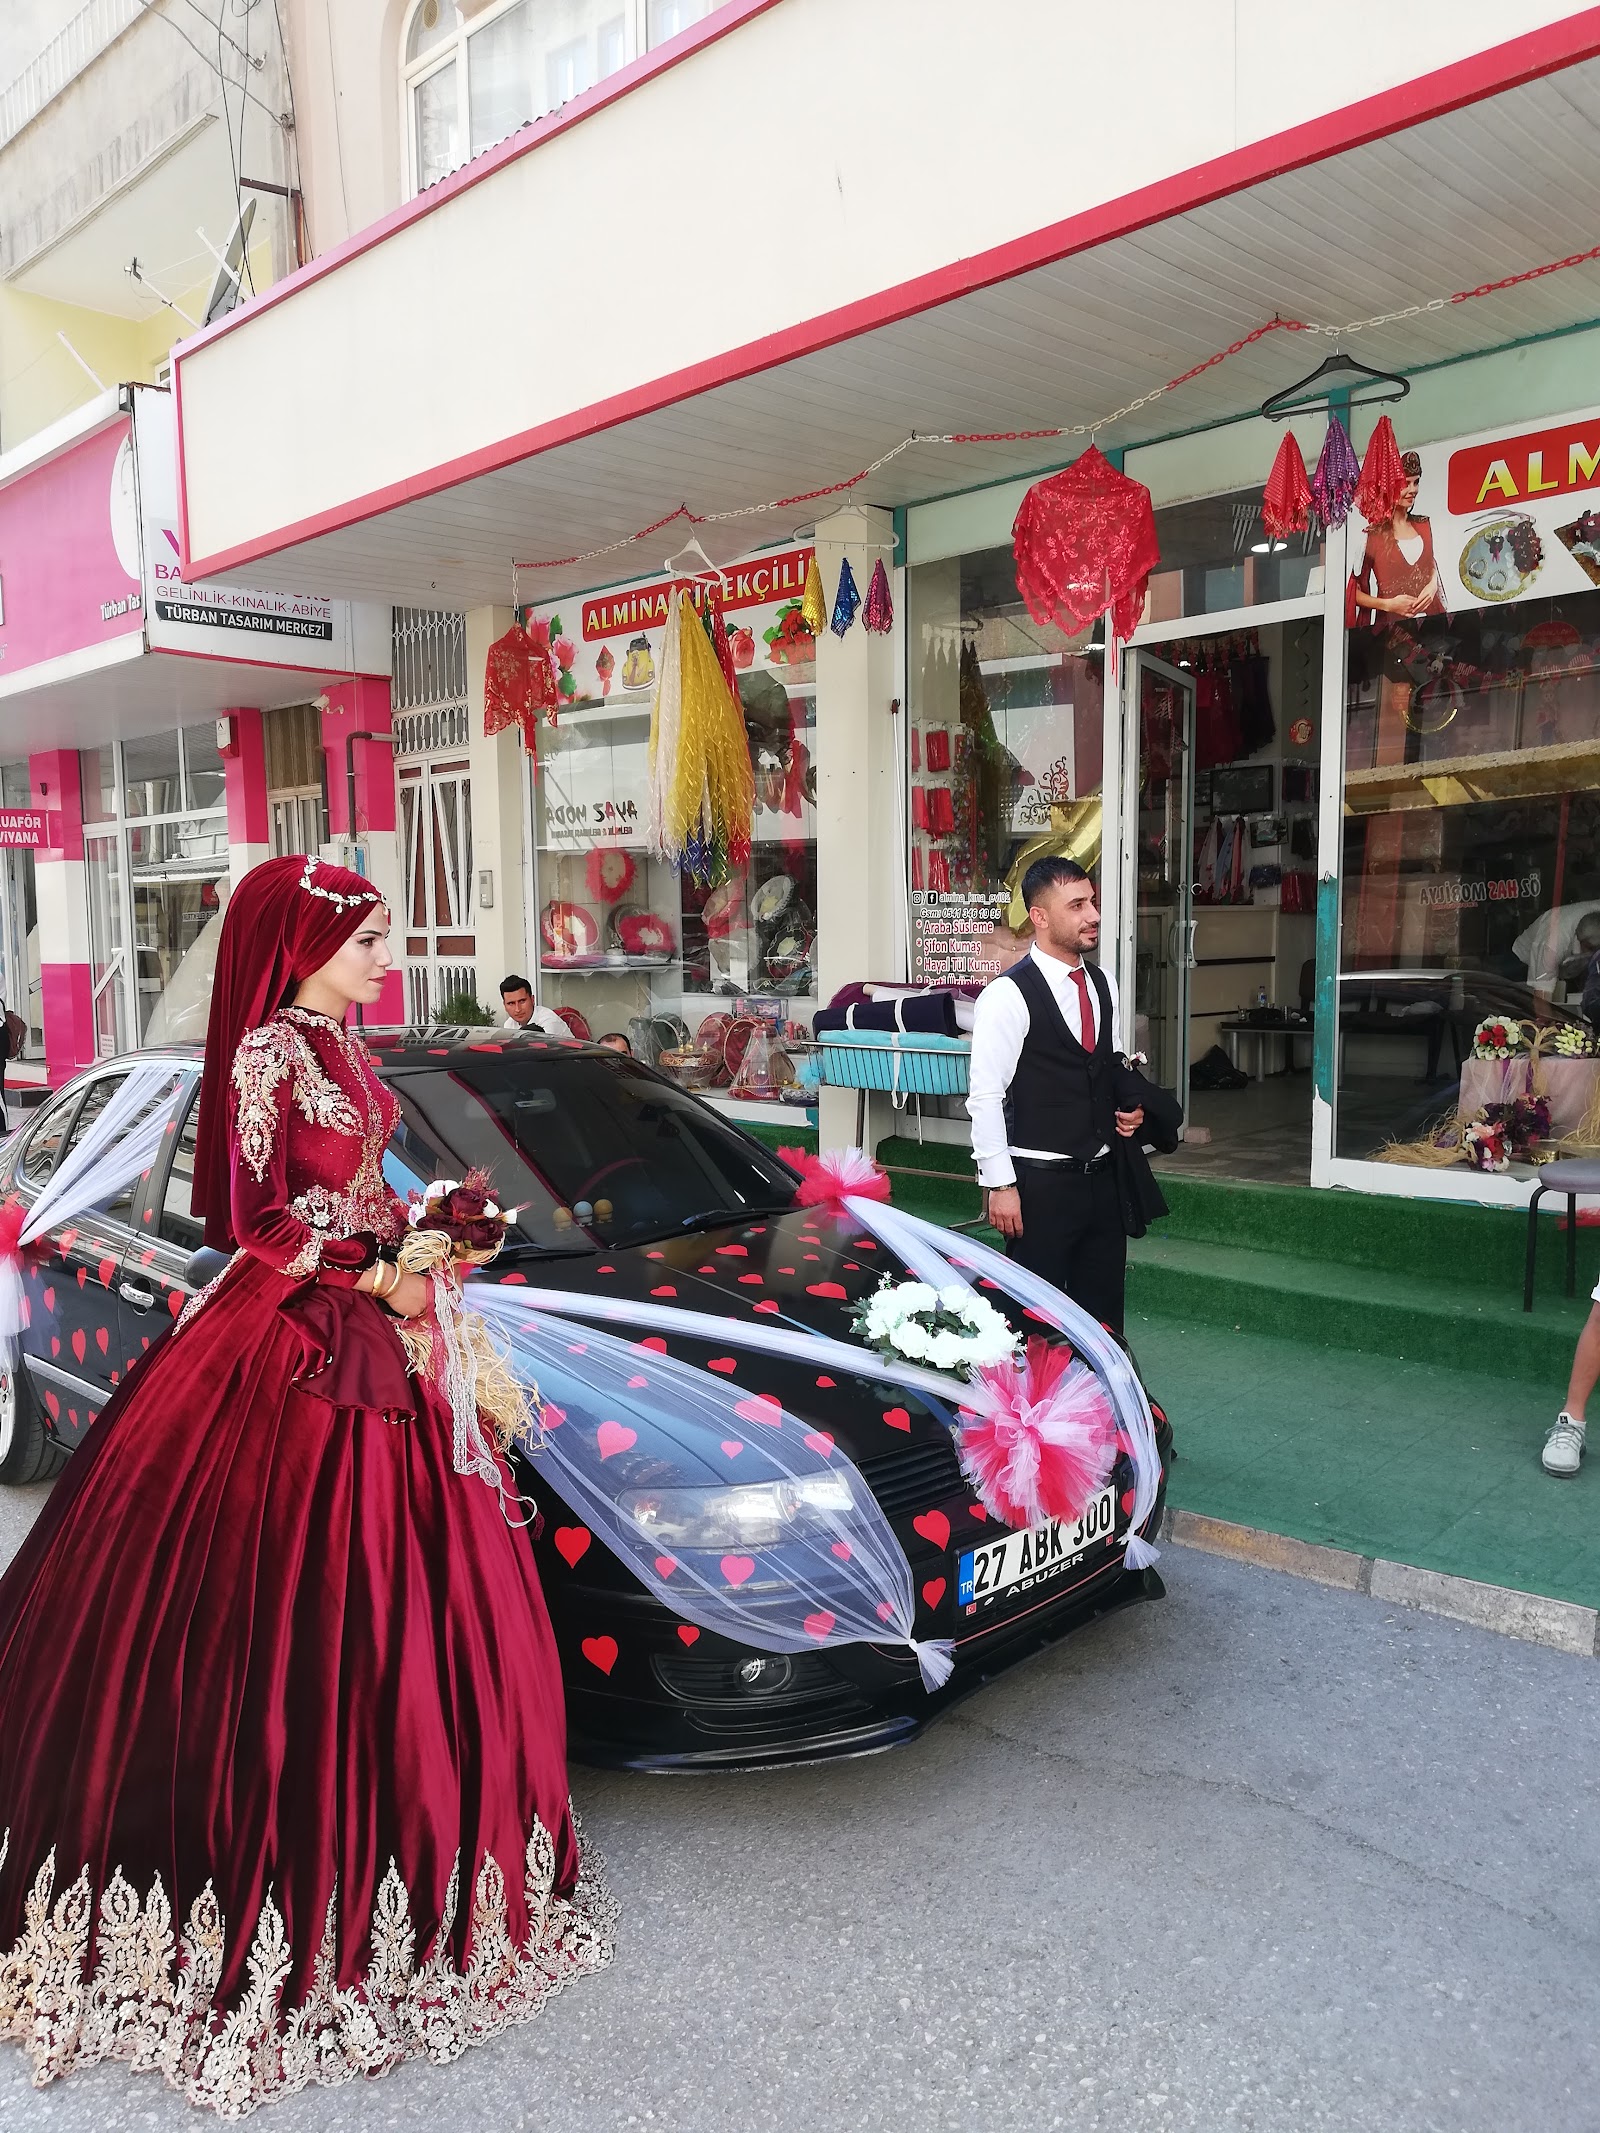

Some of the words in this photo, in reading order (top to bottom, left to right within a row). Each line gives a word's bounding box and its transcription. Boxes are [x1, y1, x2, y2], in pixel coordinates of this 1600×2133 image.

[100, 600, 128, 621] Türban
[586, 593, 669, 633] ALMİNA
[164, 603, 218, 624] TÜRBAN
[220, 612, 273, 631] TASARIM
[276, 620, 325, 637] MERKEZİ
[0, 813, 41, 829] UAFÖR
[920, 908, 941, 918] Gsm:
[942, 908, 961, 918] 0541
[990, 908, 1001, 919] 95
[924, 919, 951, 934] Araba
[953, 919, 994, 934] Süsleme
[924, 939, 948, 955] Şifon
[949, 939, 981, 956] Kumaş
[924, 957, 950, 974] Hayal
[951, 957, 966, 972] Tül
[967, 957, 1001, 975] Kumaş
[974, 1544, 1007, 1594] 27
[1019, 1517, 1063, 1575] ABK
[1072, 1494, 1111, 1547] 300
[1006, 1552, 1084, 1598] ABUZER
[960, 1580, 973, 1596] TR
